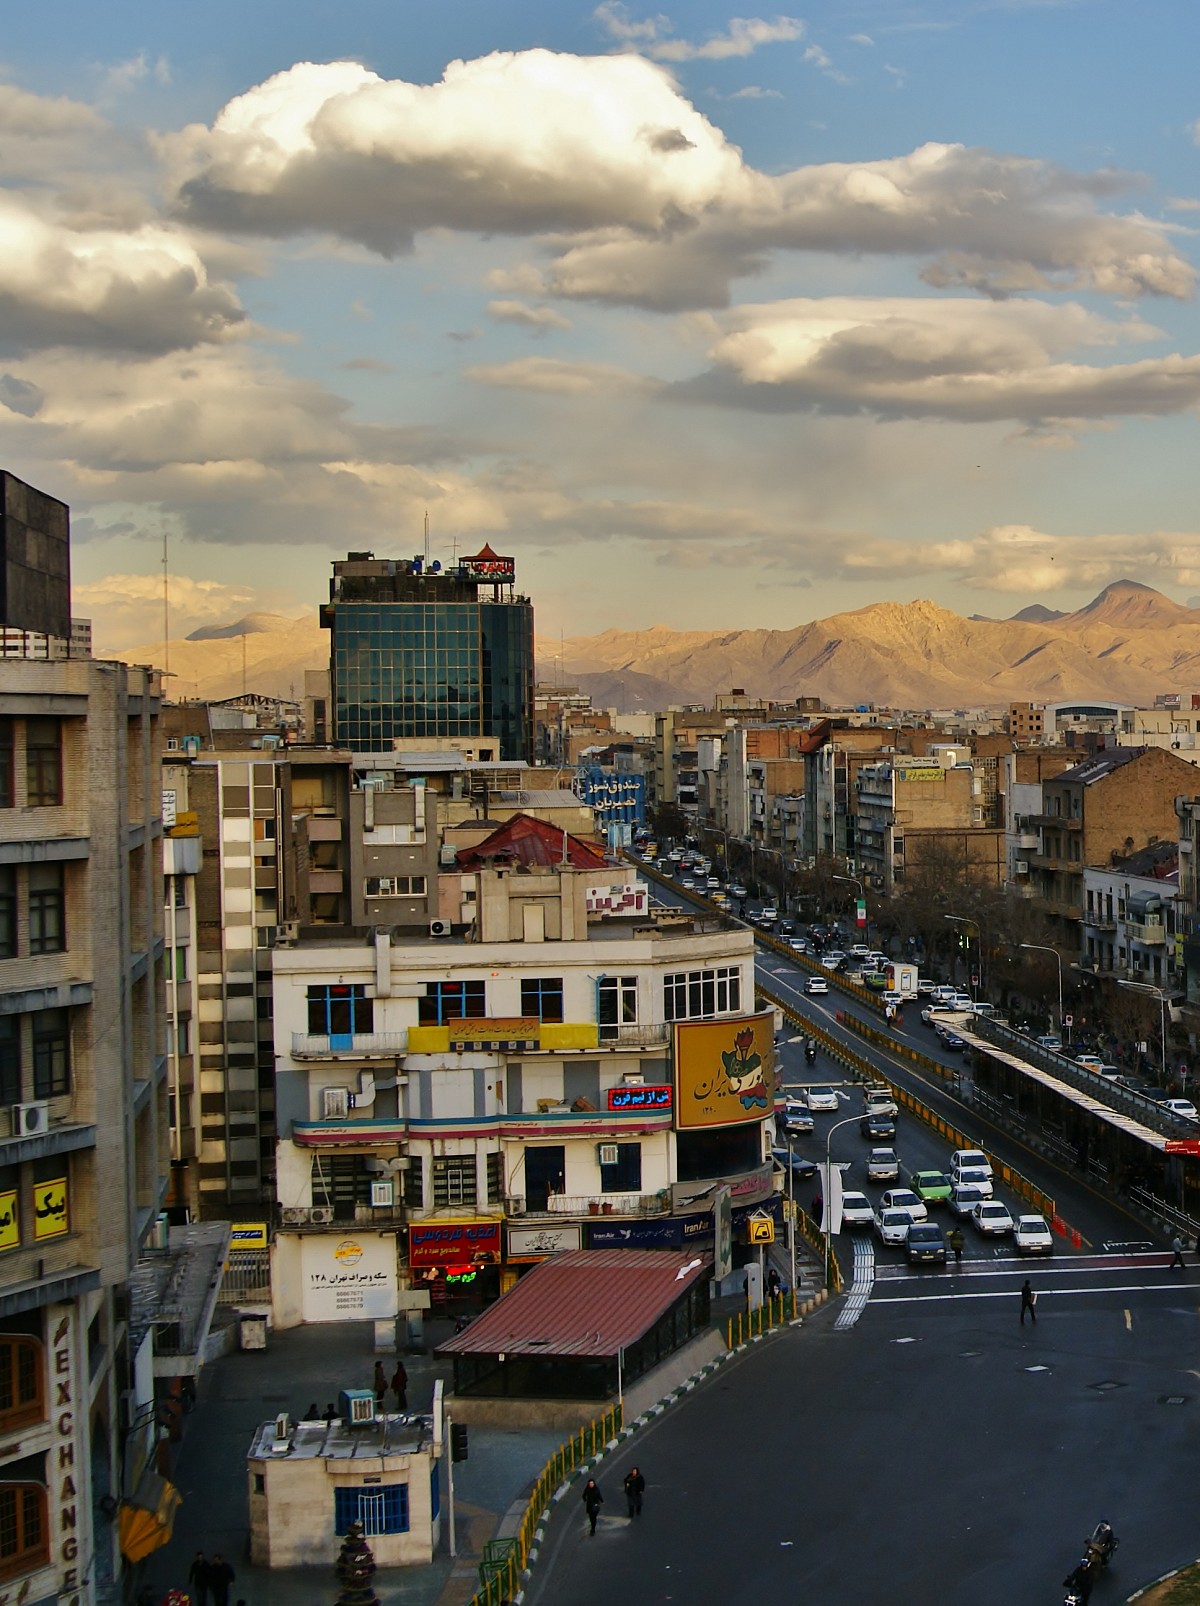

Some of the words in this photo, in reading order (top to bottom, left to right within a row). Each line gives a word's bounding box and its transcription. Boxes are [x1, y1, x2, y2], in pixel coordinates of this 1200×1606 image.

[588, 780, 609, 793] نسوز
[608, 780, 641, 794] صندوق
[646, 1090, 656, 1104] از
[413, 1227, 463, 1245] فردوسی
[330, 1273, 348, 1284] تهران
[373, 1271, 387, 1279] سکه
[56, 1348, 78, 1592] EXCHANGE
